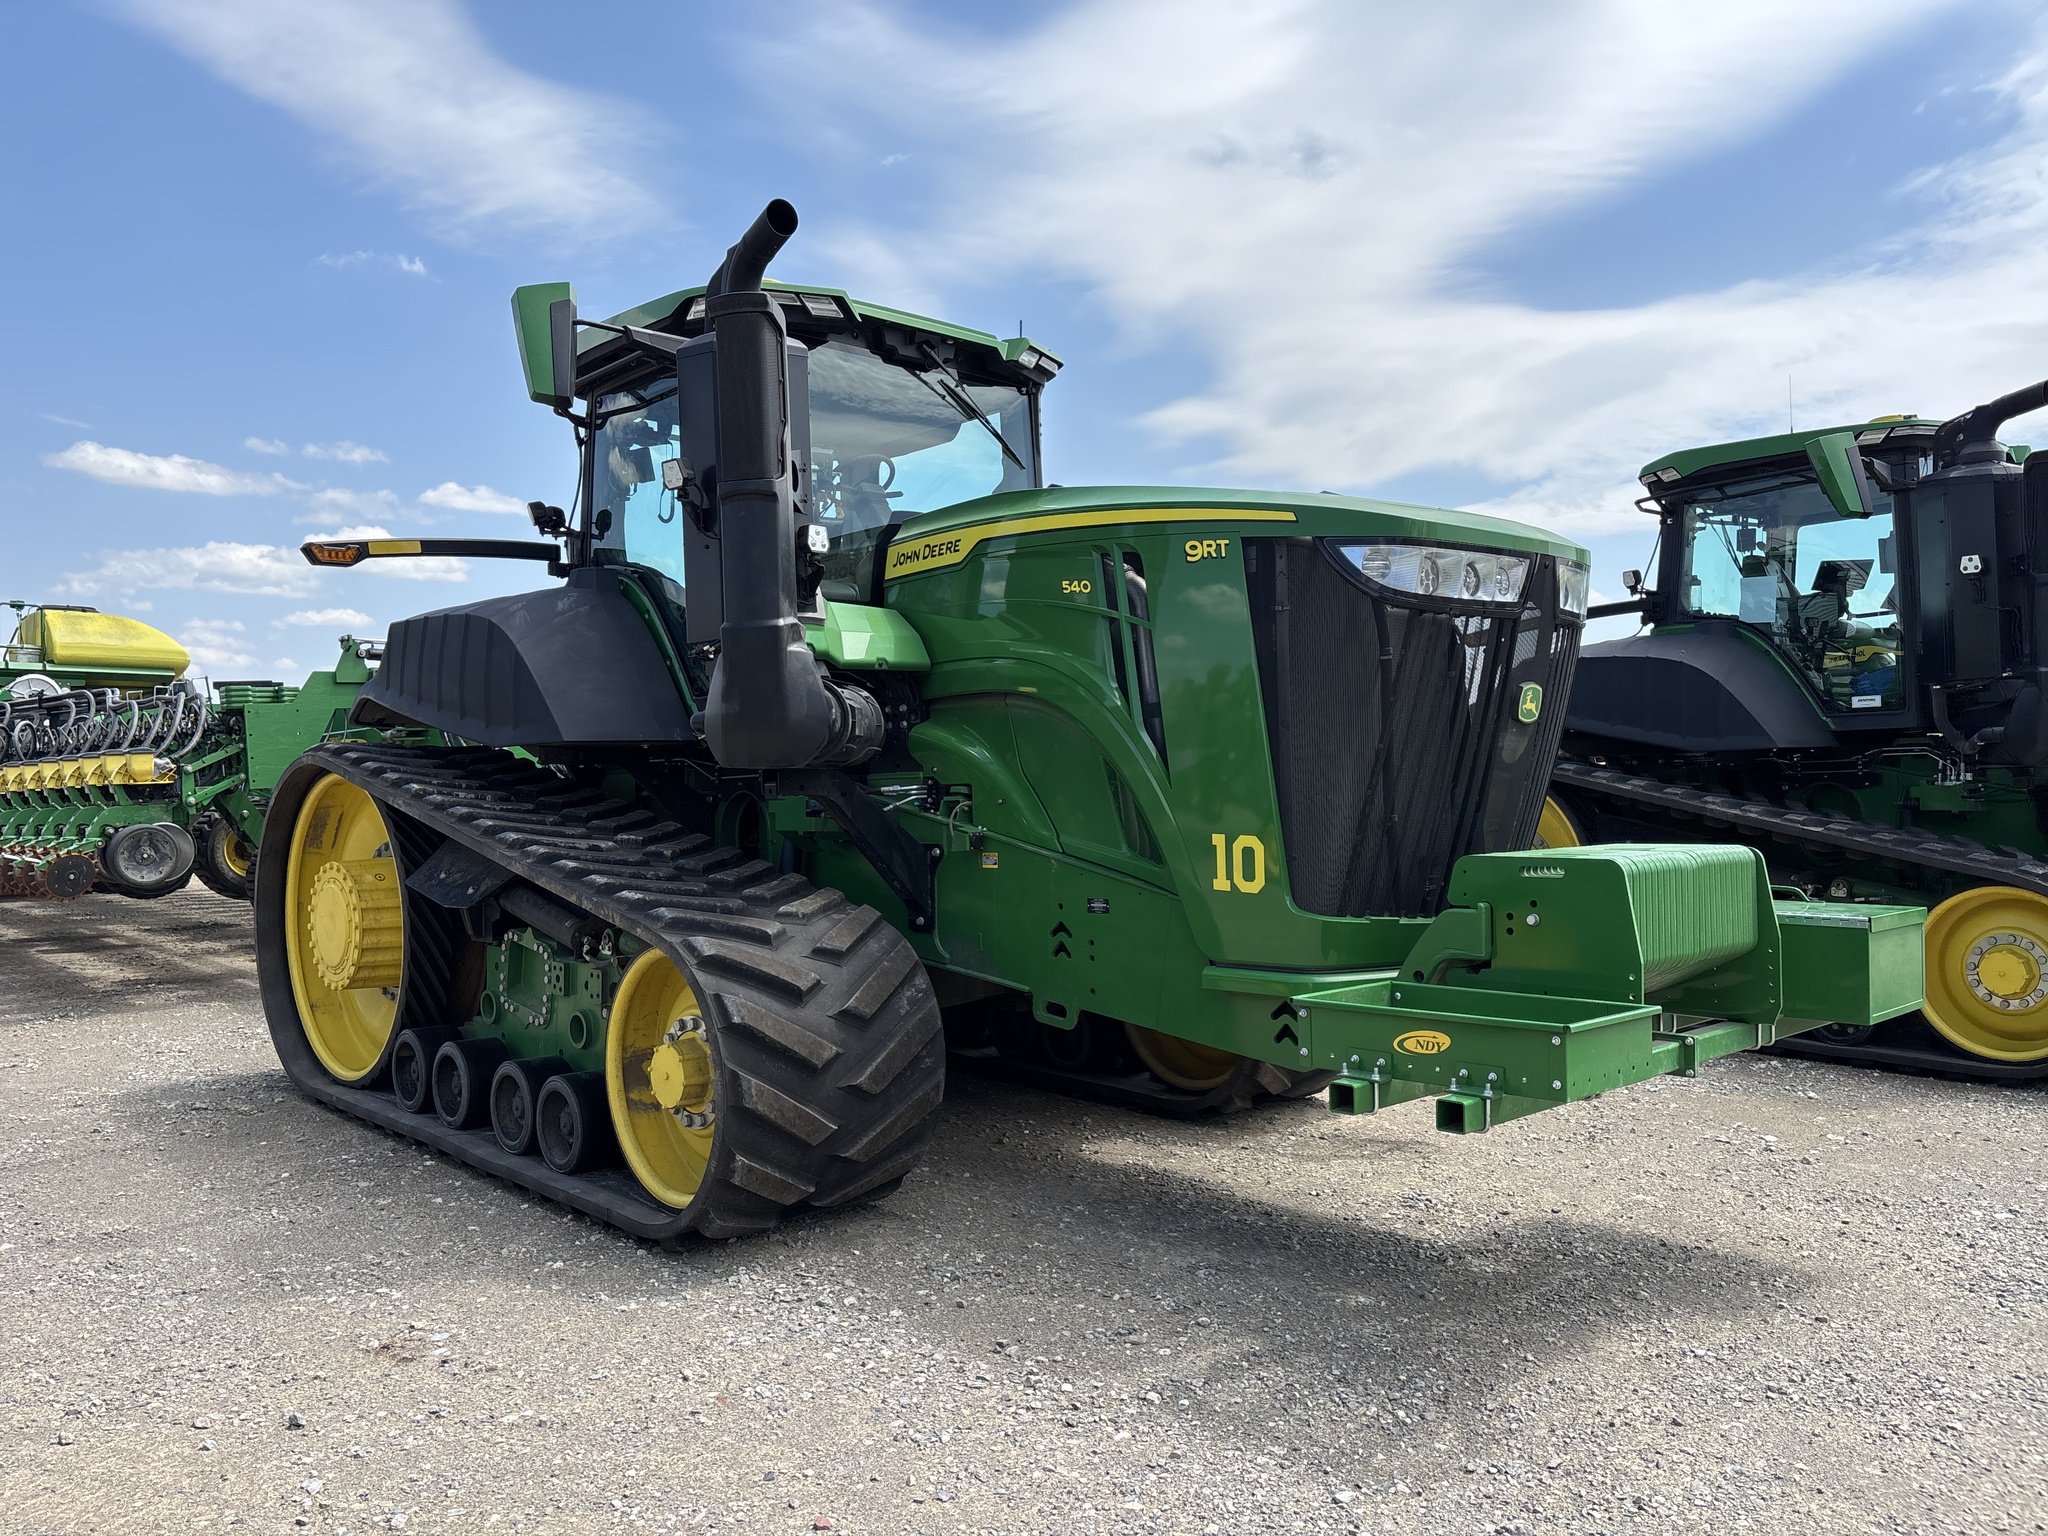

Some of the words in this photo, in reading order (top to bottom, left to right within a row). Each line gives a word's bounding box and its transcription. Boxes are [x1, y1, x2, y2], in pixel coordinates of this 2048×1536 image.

[893, 549, 921, 568] JOHN
[922, 539, 961, 560] DEERE
[1184, 539, 1230, 563] 9RT
[1061, 580, 1092, 594] 540
[1211, 833, 1266, 894] 10
[1414, 1039, 1446, 1053] NDY
